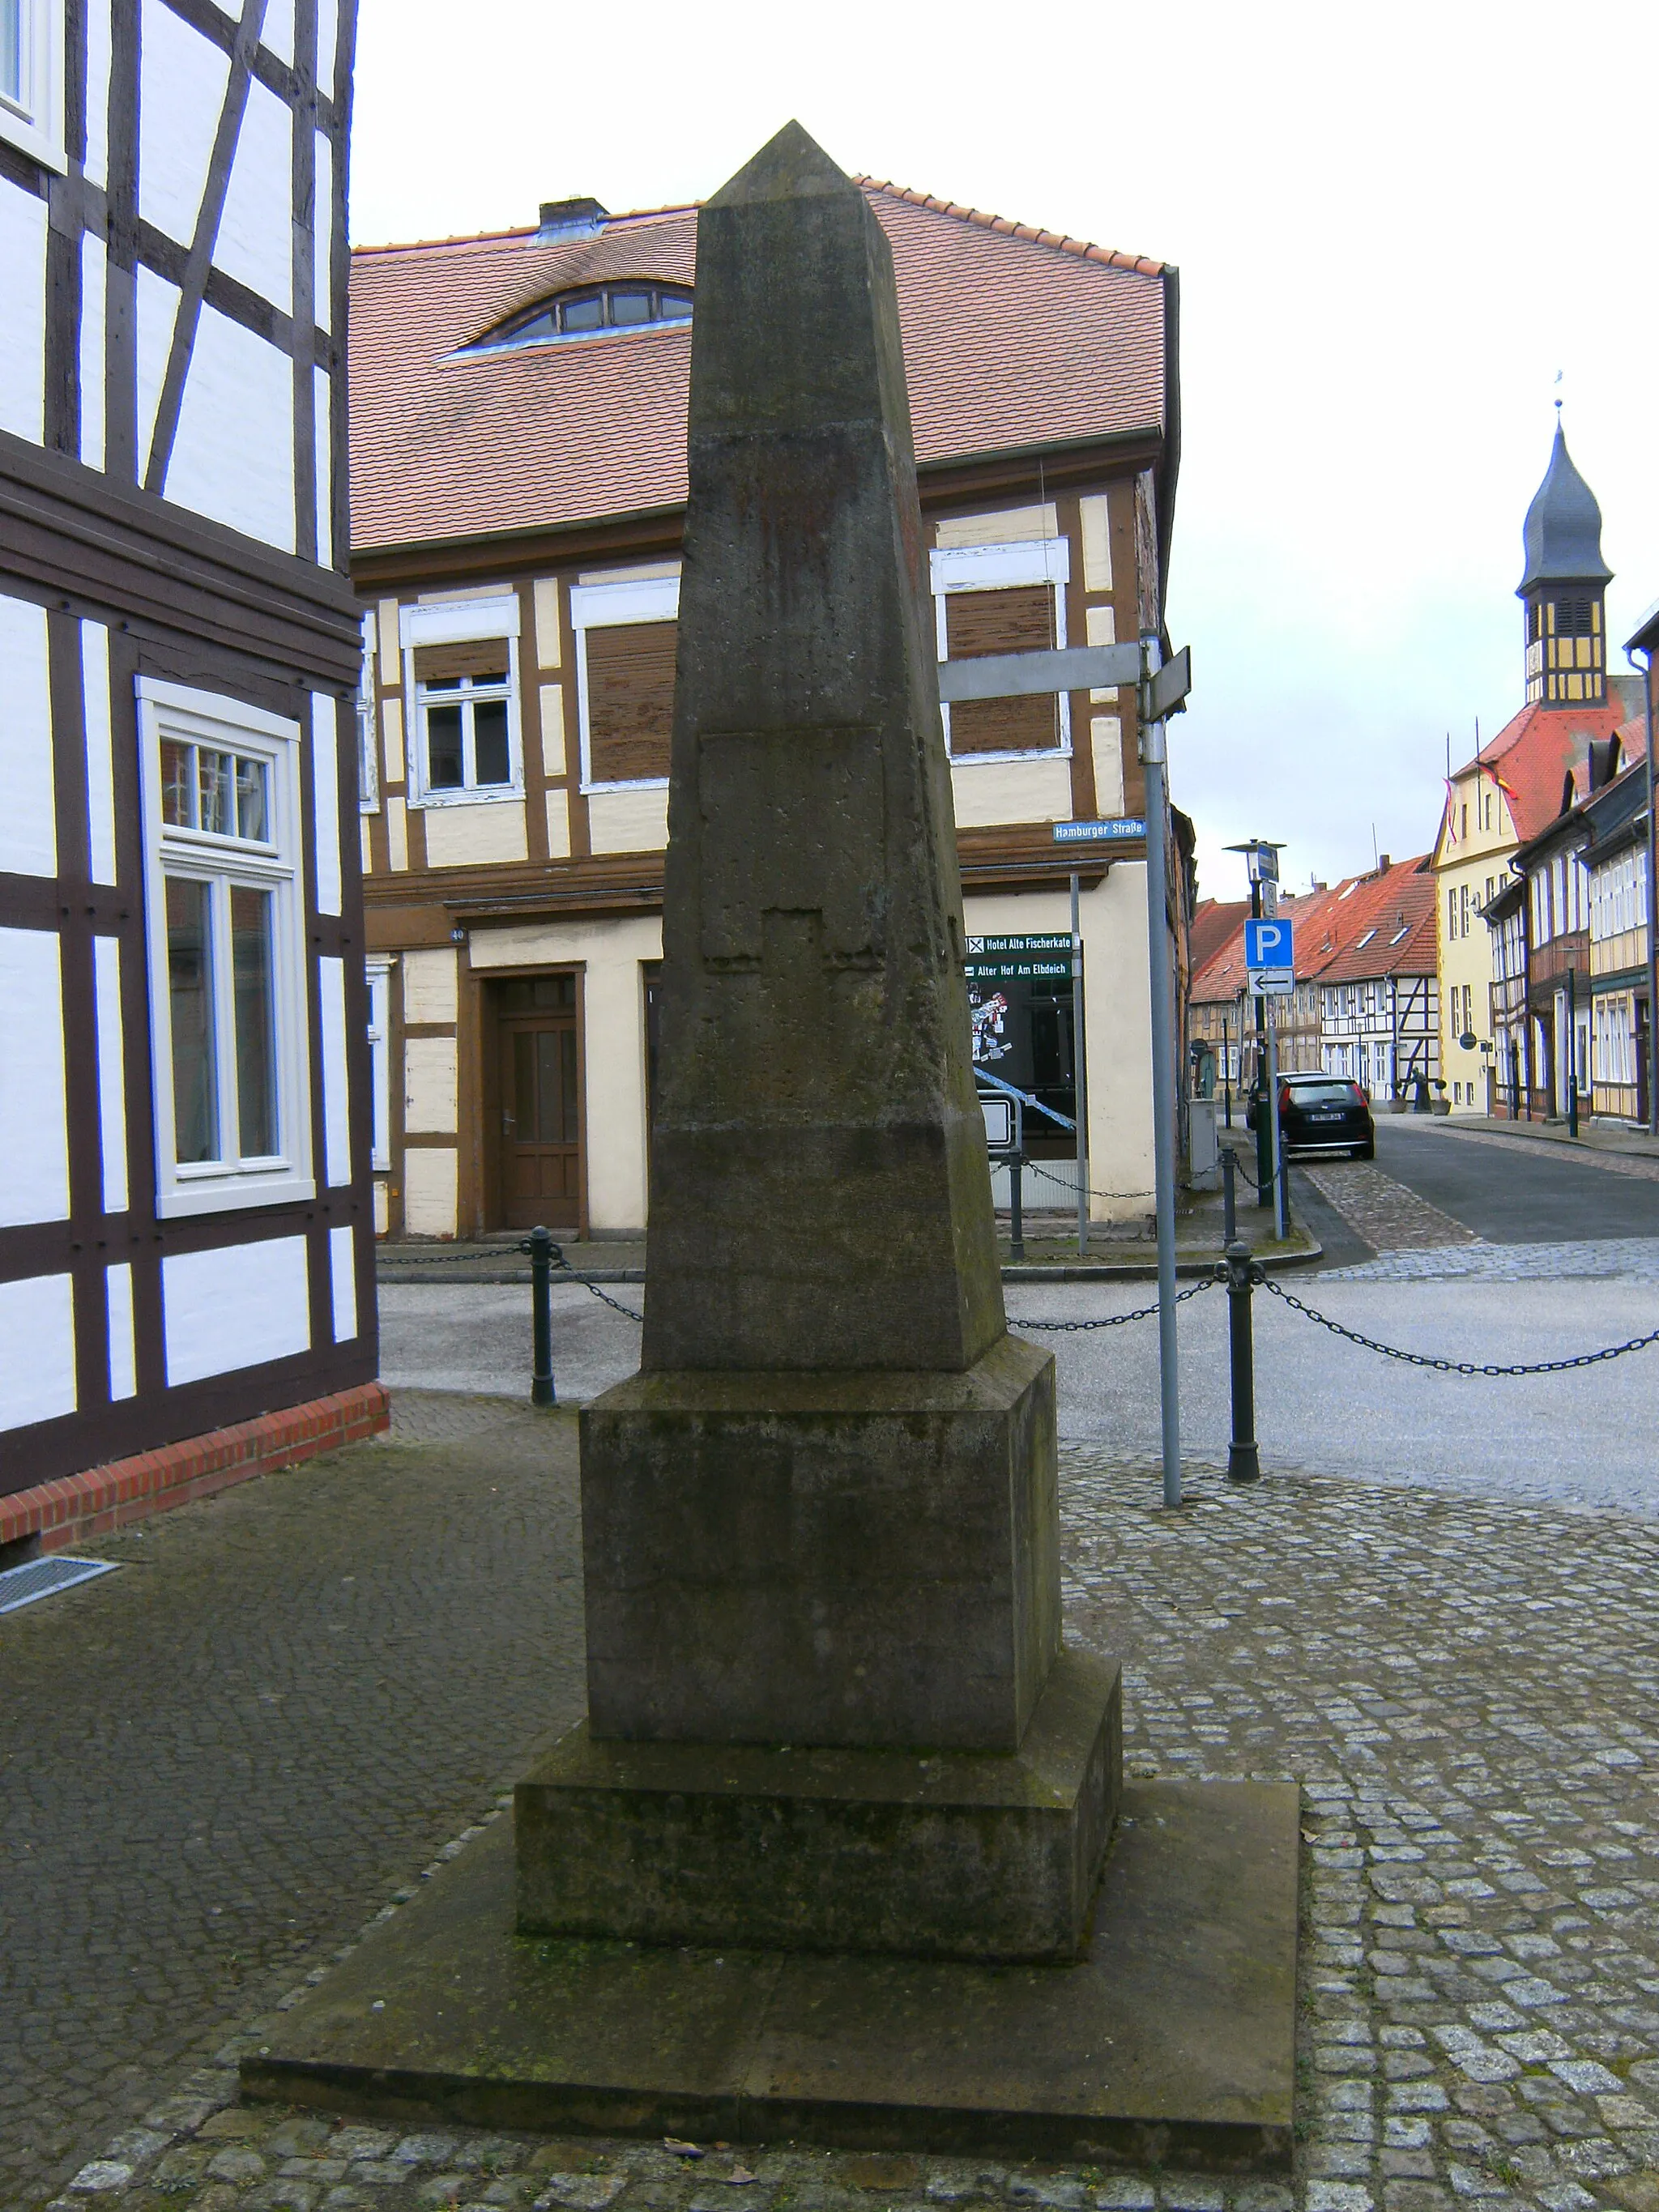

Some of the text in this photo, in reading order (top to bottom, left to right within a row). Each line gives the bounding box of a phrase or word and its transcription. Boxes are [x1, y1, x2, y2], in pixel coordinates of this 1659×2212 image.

[1056, 822, 1142, 837] Hamburger Straße
[987, 937, 1071, 950] Hotel Alte Fischerkate
[1256, 925, 1282, 961] P
[978, 964, 1066, 977] Alter Hof Am Elbdeich
